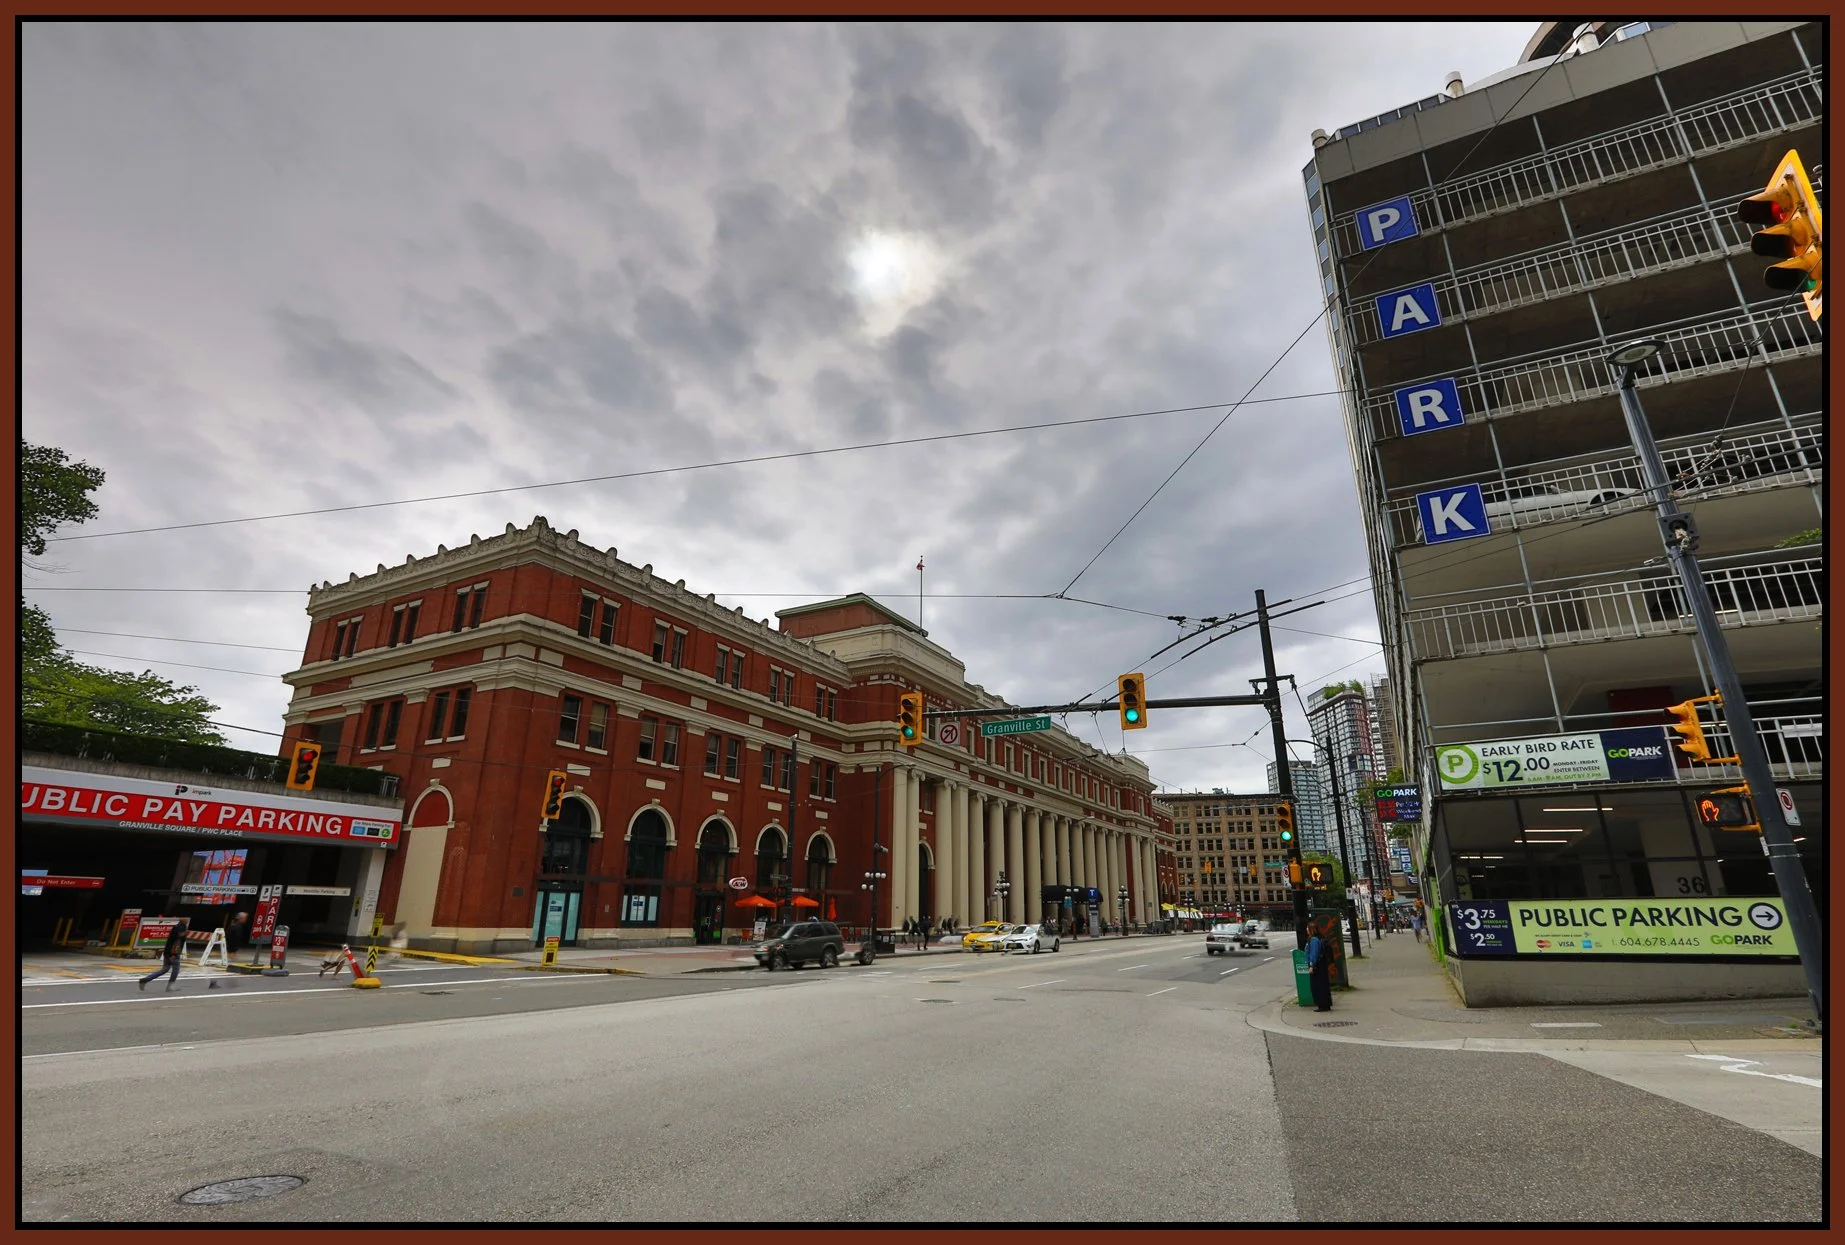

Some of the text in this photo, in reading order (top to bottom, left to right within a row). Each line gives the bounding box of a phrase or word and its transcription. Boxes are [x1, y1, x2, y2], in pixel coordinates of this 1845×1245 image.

[1367, 207, 1400, 242] P
[1391, 294, 1431, 332] A
[1408, 388, 1450, 428] R
[1429, 491, 1476, 536] K
[987, 719, 1045, 734] Granville St
[1481, 739, 1595, 757] EARLY BIRD RATE
[1607, 746, 1662, 758] GOPARK
[1483, 756, 1550, 782] $12.00
[1376, 788, 1417, 798] GOPARK
[142, 798, 207, 823] PAY
[217, 805, 343, 835] PARKING
[119, 820, 163, 830] GRANVILLE
[165, 824, 196, 833] SQUARE
[201, 827, 219, 835] PWC
[220, 828, 243, 837] PLACE
[1089, 888, 1095, 896] T
[1677, 876, 1706, 894] 36
[264, 898, 278, 933] PARK
[1457, 908, 1496, 930] $3.75
[1519, 906, 1743, 927] PUBLIC PARKING
[1470, 932, 1495, 946] $2.50
[1620, 937, 1700, 947] 604.678.4445
[1710, 934, 1773, 945] GOPARK
